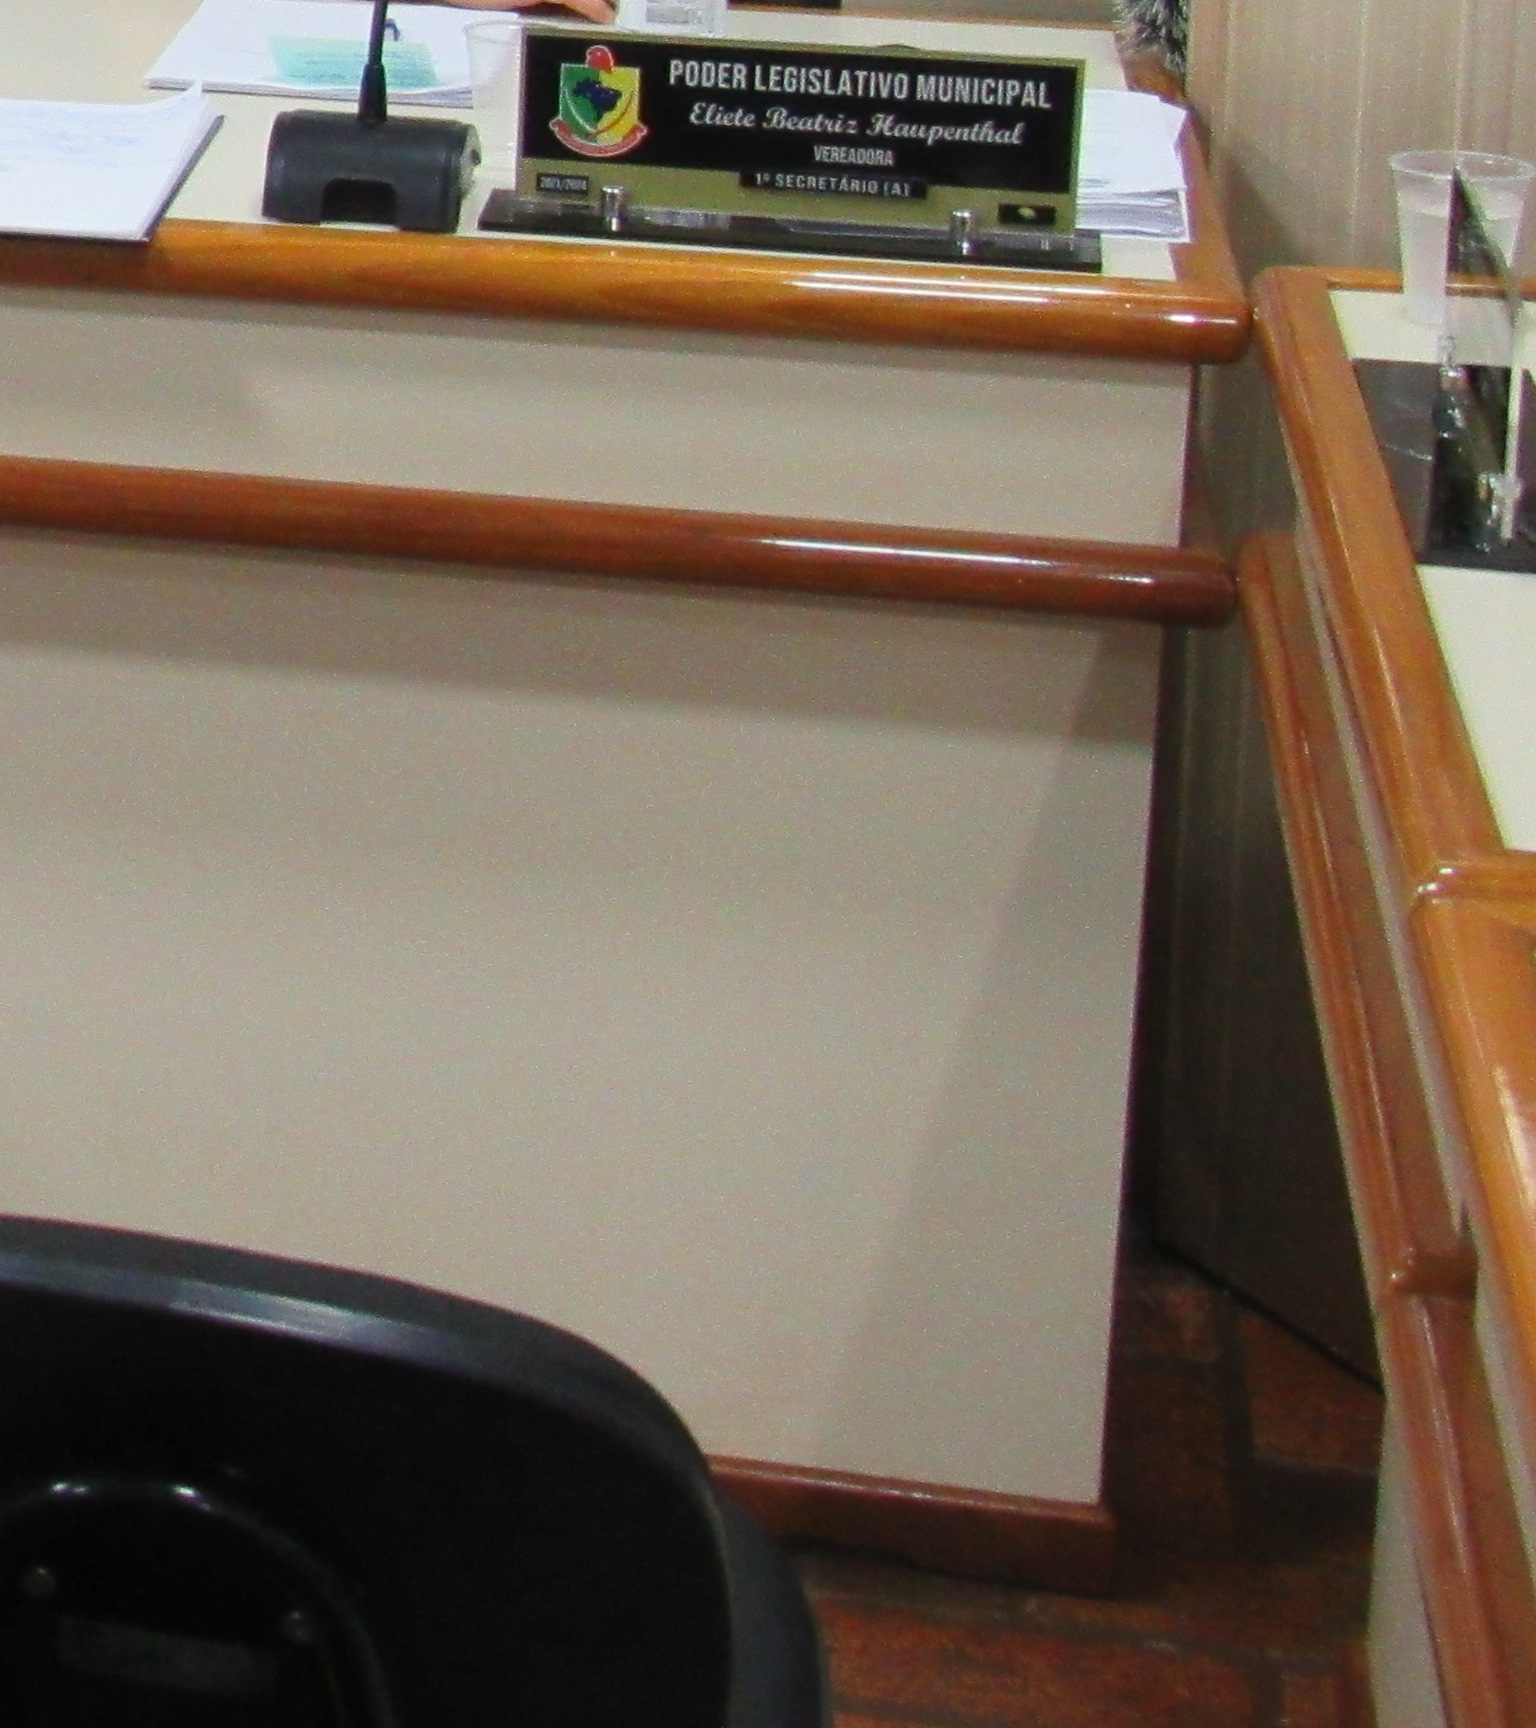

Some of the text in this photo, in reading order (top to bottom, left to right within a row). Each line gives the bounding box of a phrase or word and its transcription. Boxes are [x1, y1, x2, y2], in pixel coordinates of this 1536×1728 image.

[668, 59, 1053, 110] PODER LEGISLATIVO MUNICIPAL
[688, 101, 1026, 147] Eliete Beatriz Haupenthal
[812, 145, 897, 167] VEREADORA
[774, 172, 880, 197] SECRETÁRIO
